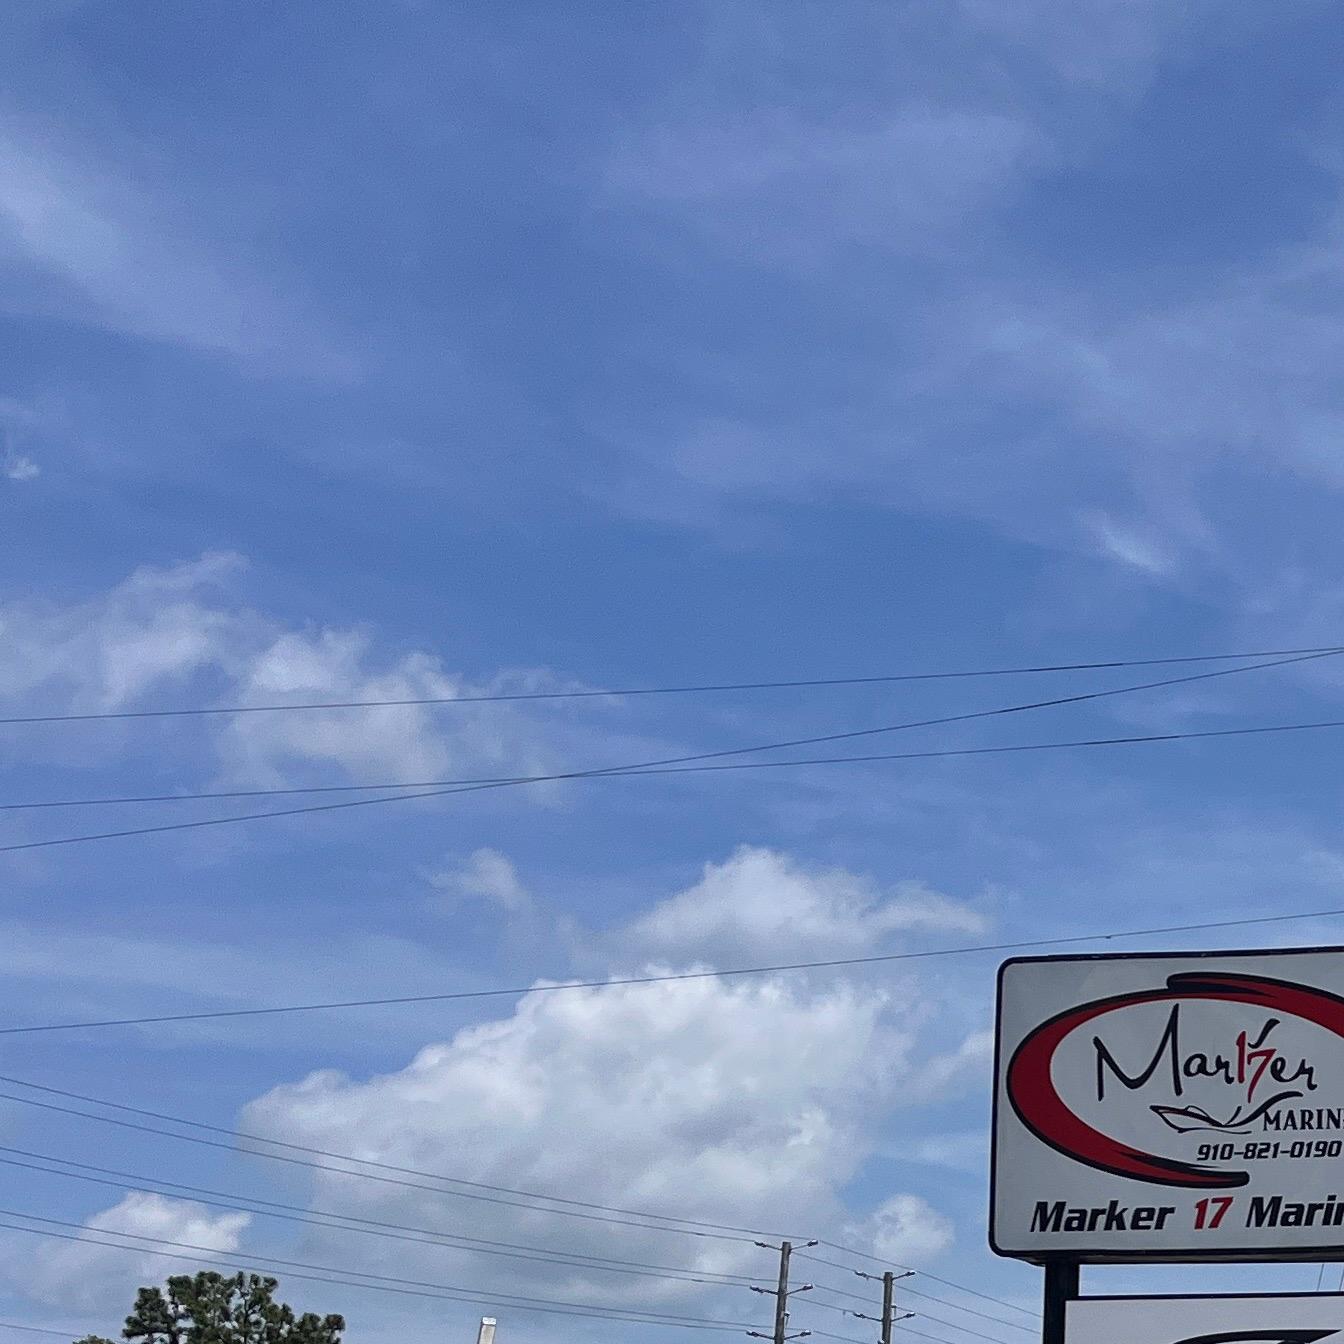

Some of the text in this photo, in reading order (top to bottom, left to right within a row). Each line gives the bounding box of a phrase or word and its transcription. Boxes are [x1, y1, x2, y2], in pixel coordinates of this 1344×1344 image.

[1196, 1140, 1342, 1161] 910-821-0190
[1030, 1201, 1175, 1233] Marker
[1193, 1197, 1234, 1230] 17
